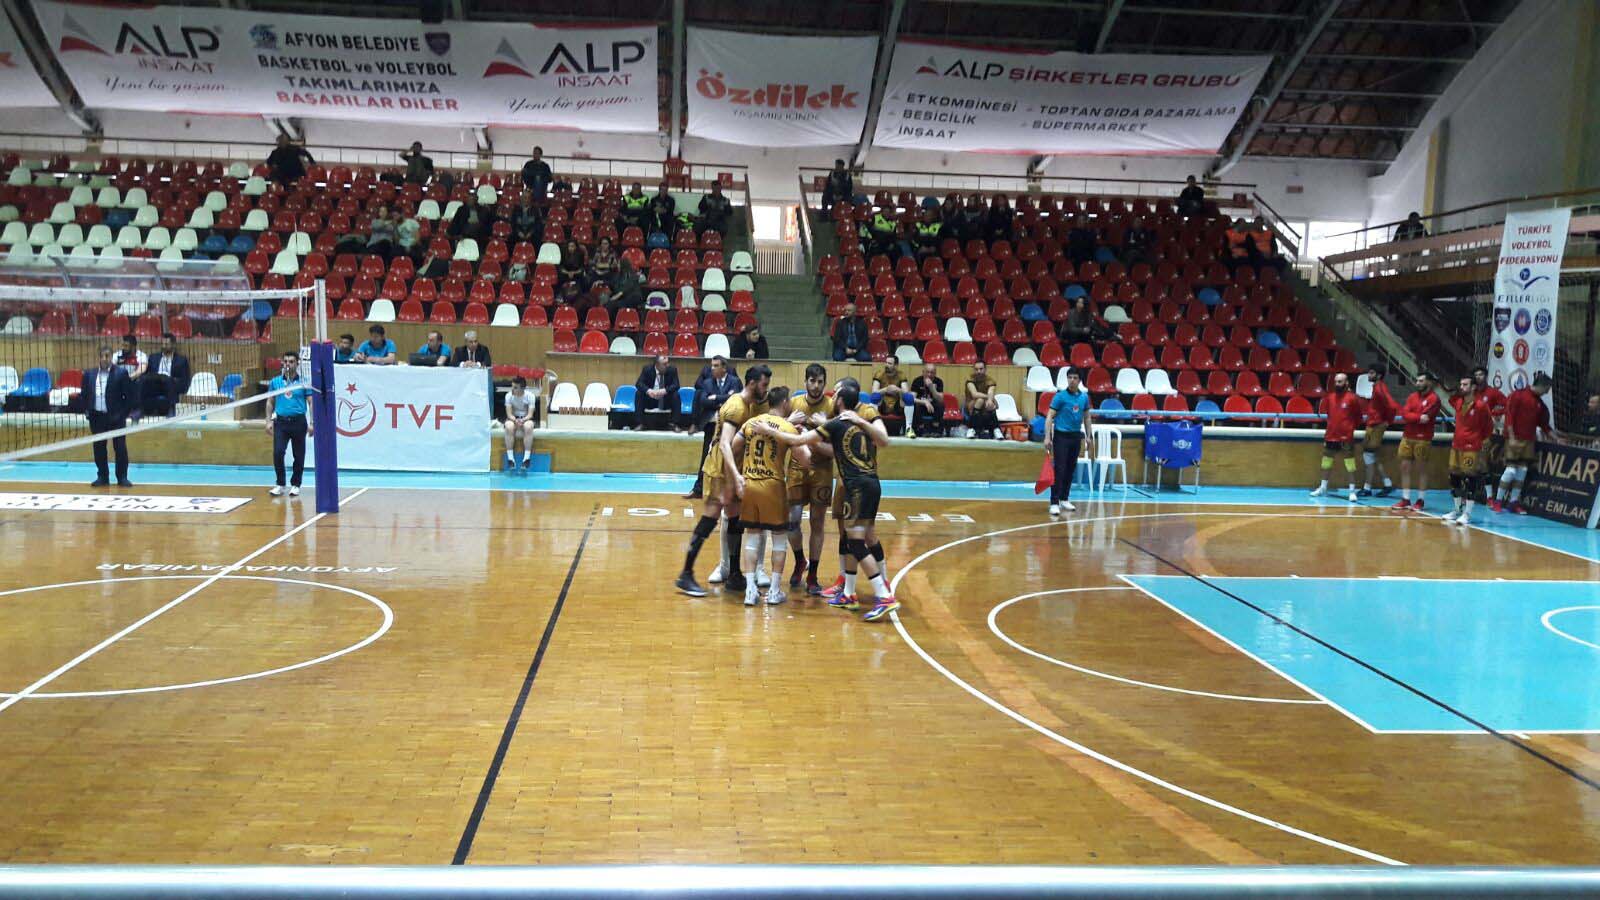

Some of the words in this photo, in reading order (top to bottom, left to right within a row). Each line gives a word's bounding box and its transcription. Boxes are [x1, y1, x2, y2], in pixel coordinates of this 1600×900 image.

[285, 32, 338, 48] AFYON
[257, 54, 351, 73] BASKETBOL
[355, 63, 372, 73] ve
[375, 62, 457, 76] VOLEYBOL
[540, 41, 645, 74] ALP
[943, 59, 1004, 80] ALP
[1153, 74, 1240, 87] GRUBU
[283, 75, 440, 94] TAKIMLARIMIZA
[696, 68, 860, 110] Özdilek
[508, 98, 550, 113] Yeni
[1039, 105, 1100, 117] TOPTAN
[1103, 107, 1139, 117] GIDA
[1144, 107, 1237, 118] PAZARLAMA
[1518, 225, 1552, 235] TÜRKİYE
[1511, 241, 1552, 250] VOLEYBOL
[384, 403, 455, 430] TVF
[755, 439, 765, 456] 9
[1545, 500, 1589, 520] EMLAK
